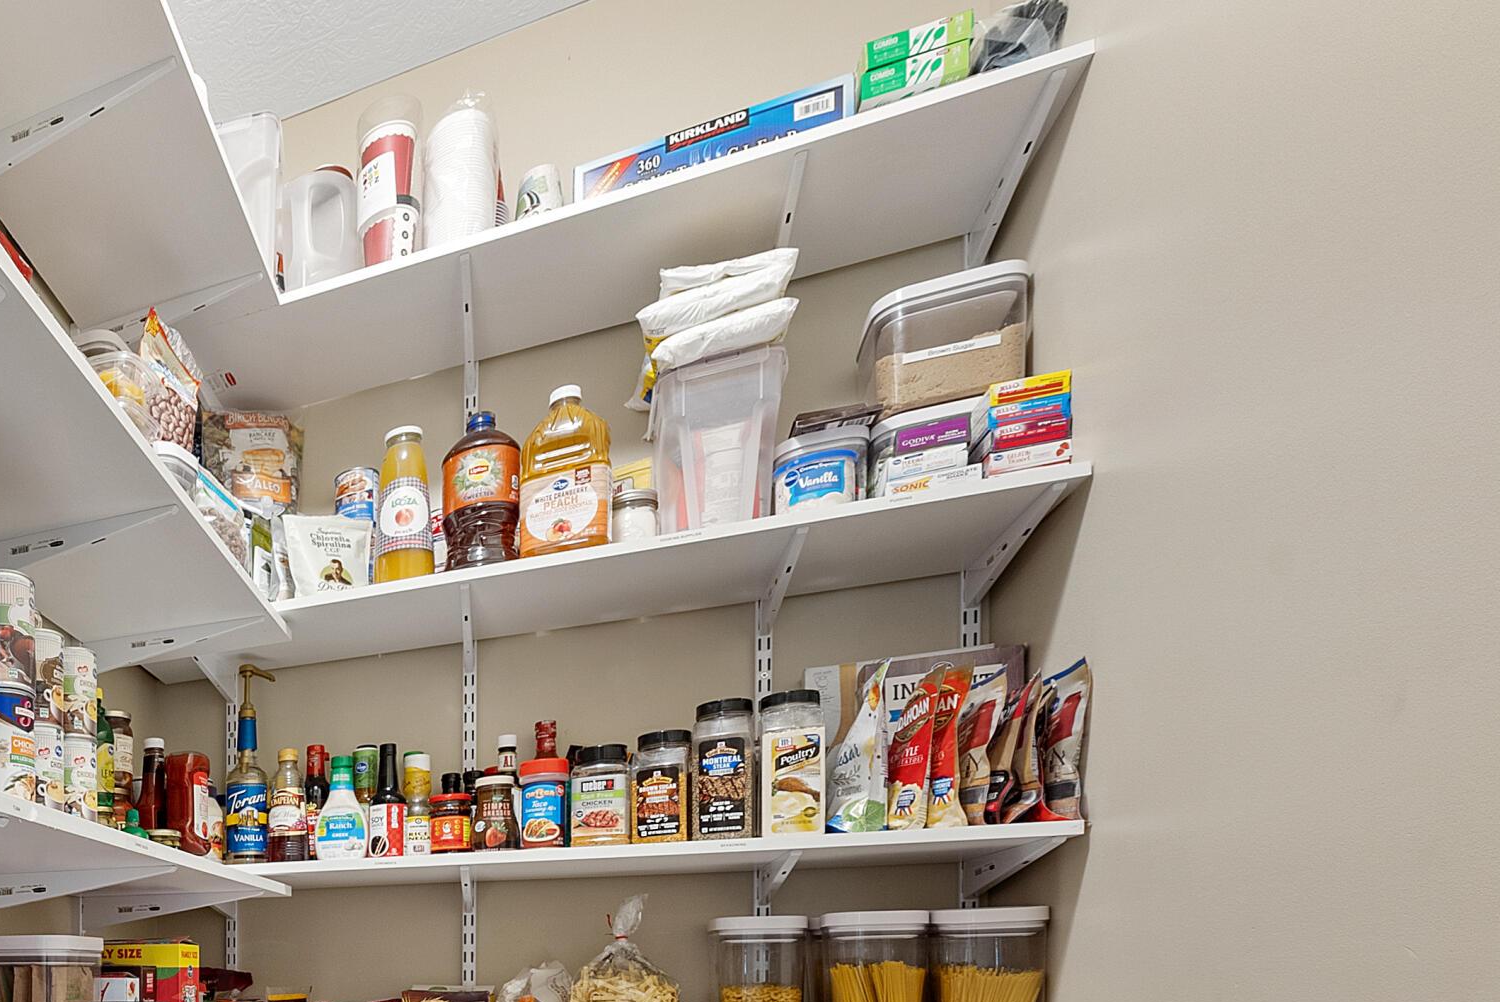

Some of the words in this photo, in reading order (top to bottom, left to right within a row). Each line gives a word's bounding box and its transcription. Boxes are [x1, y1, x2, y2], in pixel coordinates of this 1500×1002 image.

[668, 110, 748, 146] KIRKLAND
[636, 154, 661, 175] 360
[901, 434, 936, 447] GODIVA
[799, 471, 841, 489] Vanilla
[891, 479, 930, 495] SONIC
[542, 496, 579, 509] PEACH
[309, 533, 351, 543] Chlorella
[311, 539, 352, 549] Spirulina
[702, 754, 742, 766] MONTREAL
[779, 746, 816, 766] Poultry
[228, 789, 267, 815] Torani
[482, 803, 511, 811] SIMPLY
[329, 821, 353, 831] Ranch
[233, 832, 264, 842] VANILLA
[117, 949, 142, 959] SIZE
